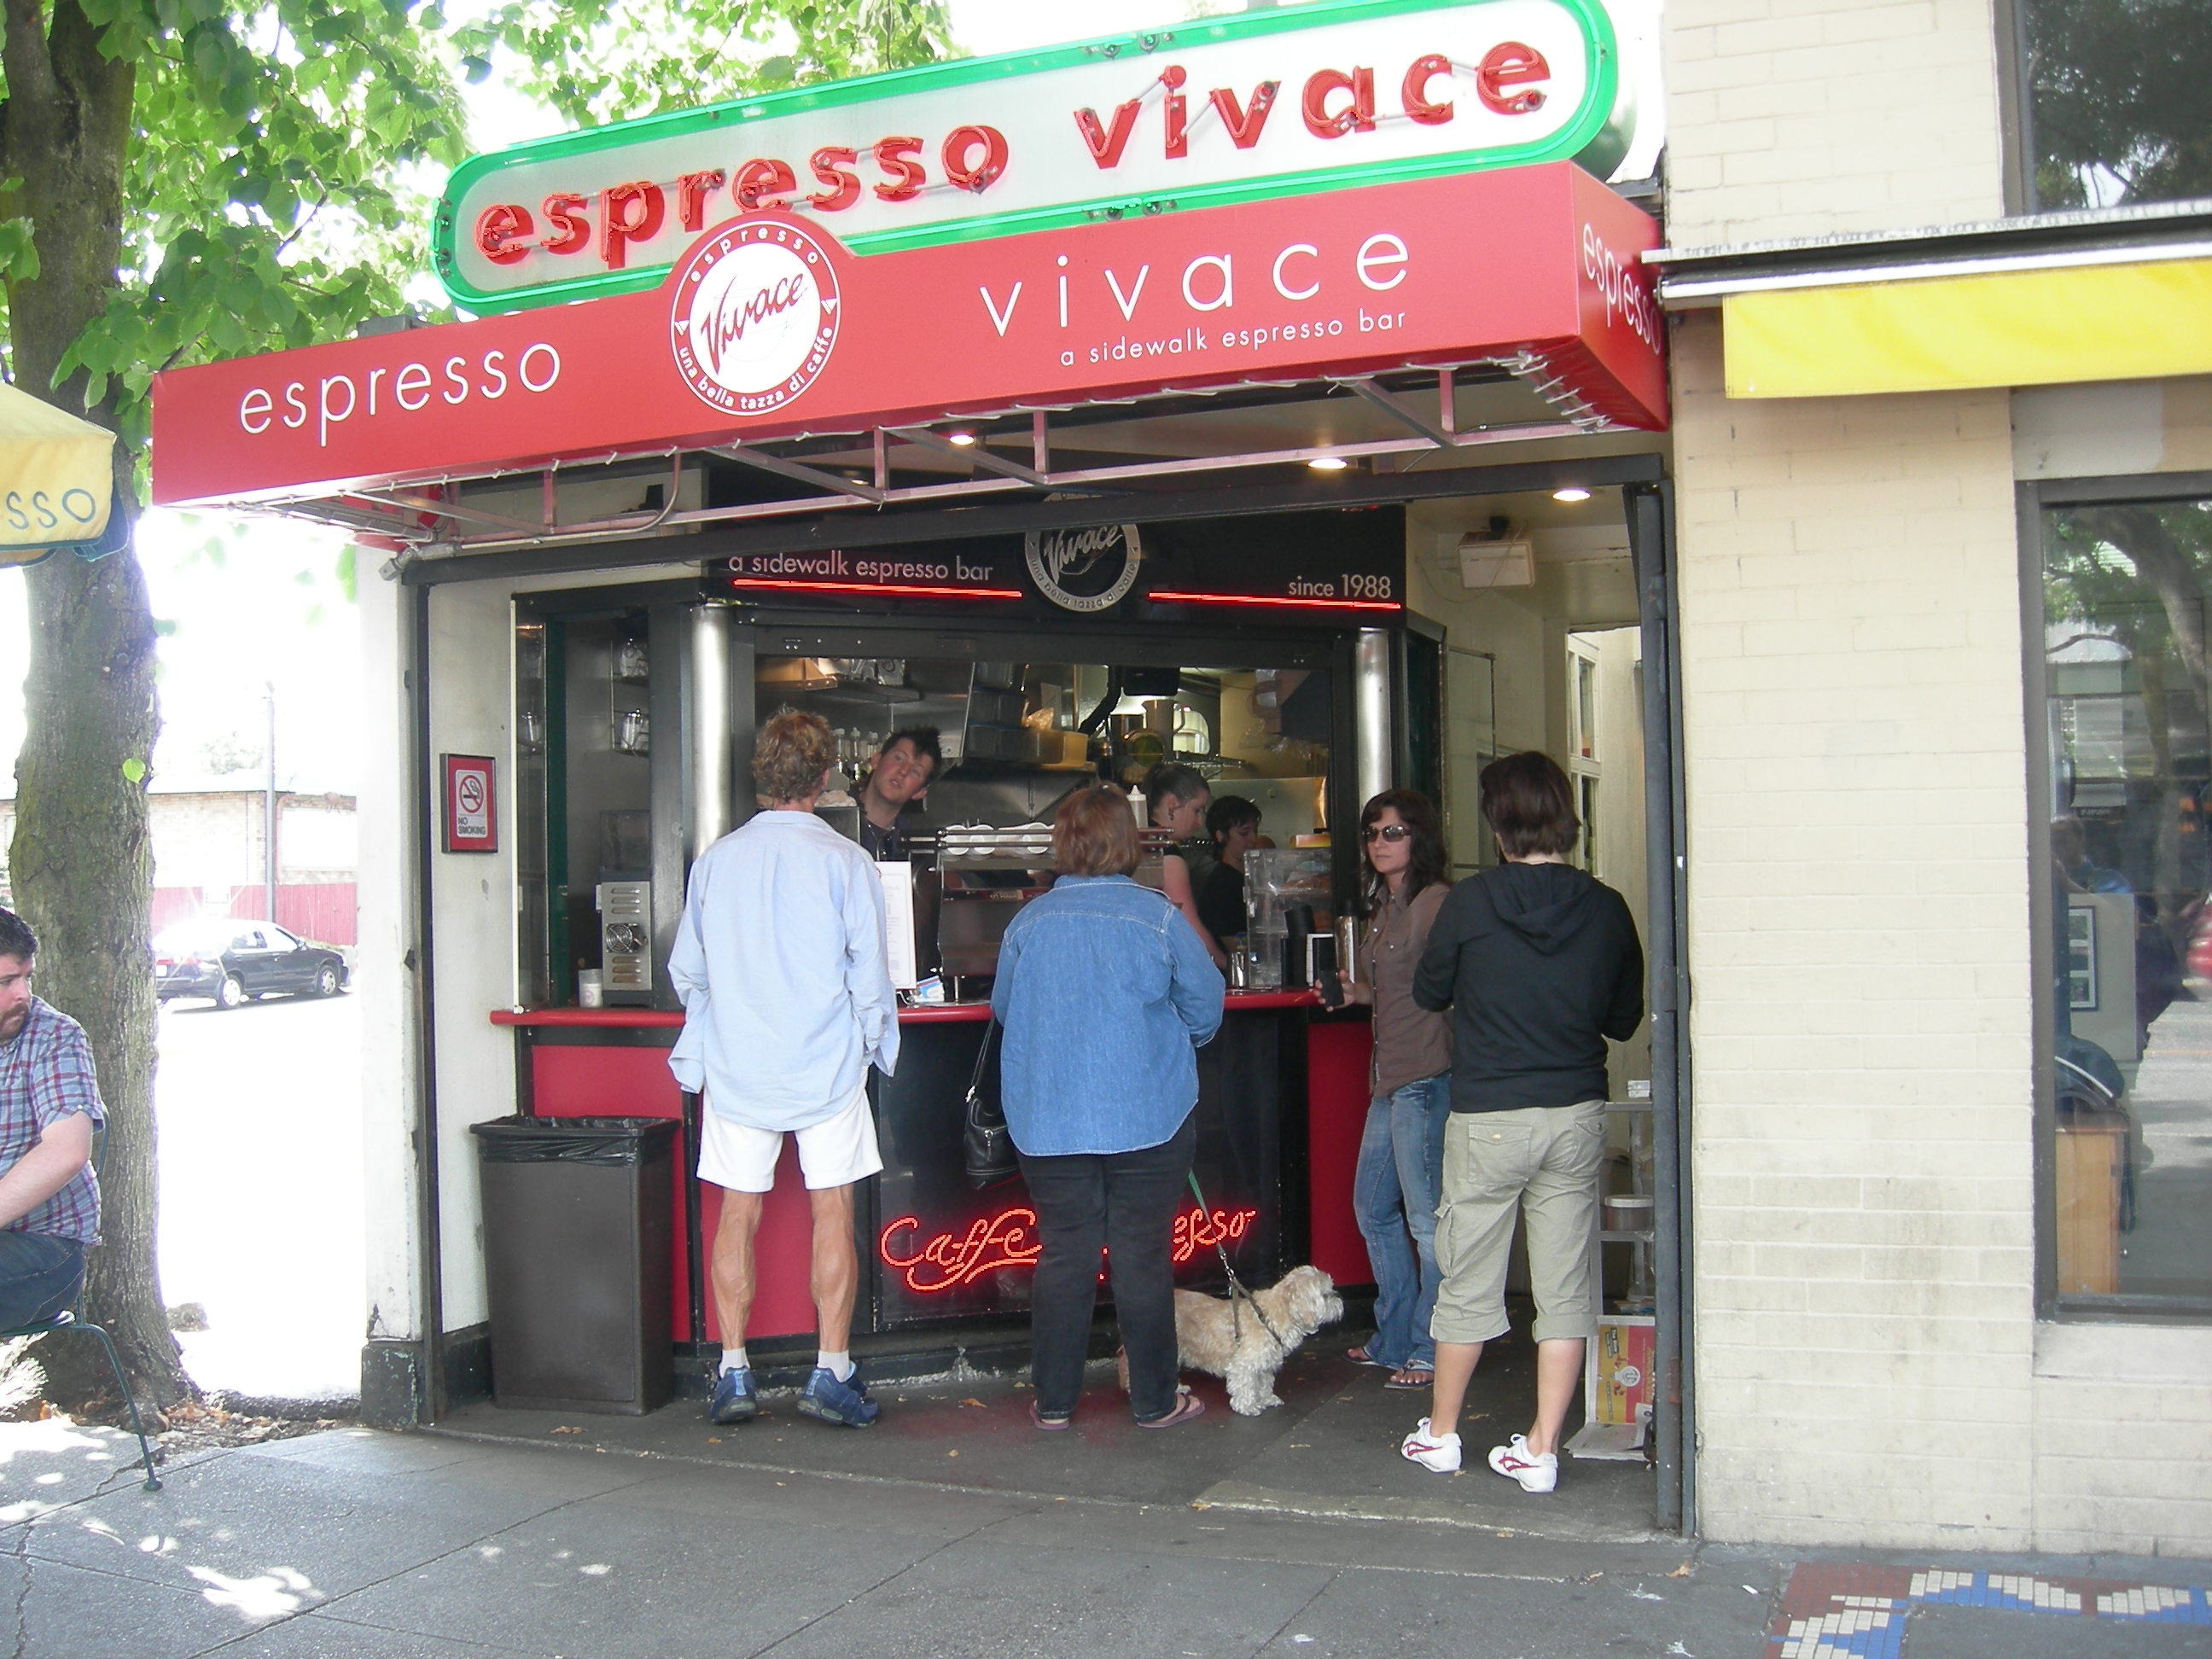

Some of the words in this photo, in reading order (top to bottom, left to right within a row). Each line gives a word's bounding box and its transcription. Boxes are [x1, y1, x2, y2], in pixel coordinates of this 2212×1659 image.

[474, 125, 1010, 270] espresso
[1074, 40, 1551, 169] vivace
[690, 227, 818, 282] espresso
[1582, 223, 1662, 355] espresso
[240, 343, 561, 448] espresso
[979, 233, 1409, 337] vivace
[700, 274, 809, 375] Vivace
[1060, 350, 1075, 366] a
[1089, 325, 1208, 364] sidewalk
[1222, 319, 1343, 351] espresso
[1359, 308, 1406, 332] bar
[679, 346, 698, 379] una
[697, 375, 734, 407] bella
[740, 390, 785, 410] tazza
[789, 372, 806, 392] di
[728, 556, 742, 573] a
[752, 550, 849, 576] sidewalk
[856, 559, 949, 584] espresso
[956, 555, 993, 581] bar
[1043, 525, 1123, 585] Vivace
[1288, 575, 1335, 597] since
[1341, 573, 1391, 598] 1988
[457, 817, 468, 825] NO
[458, 825, 486, 835] SMOKING
